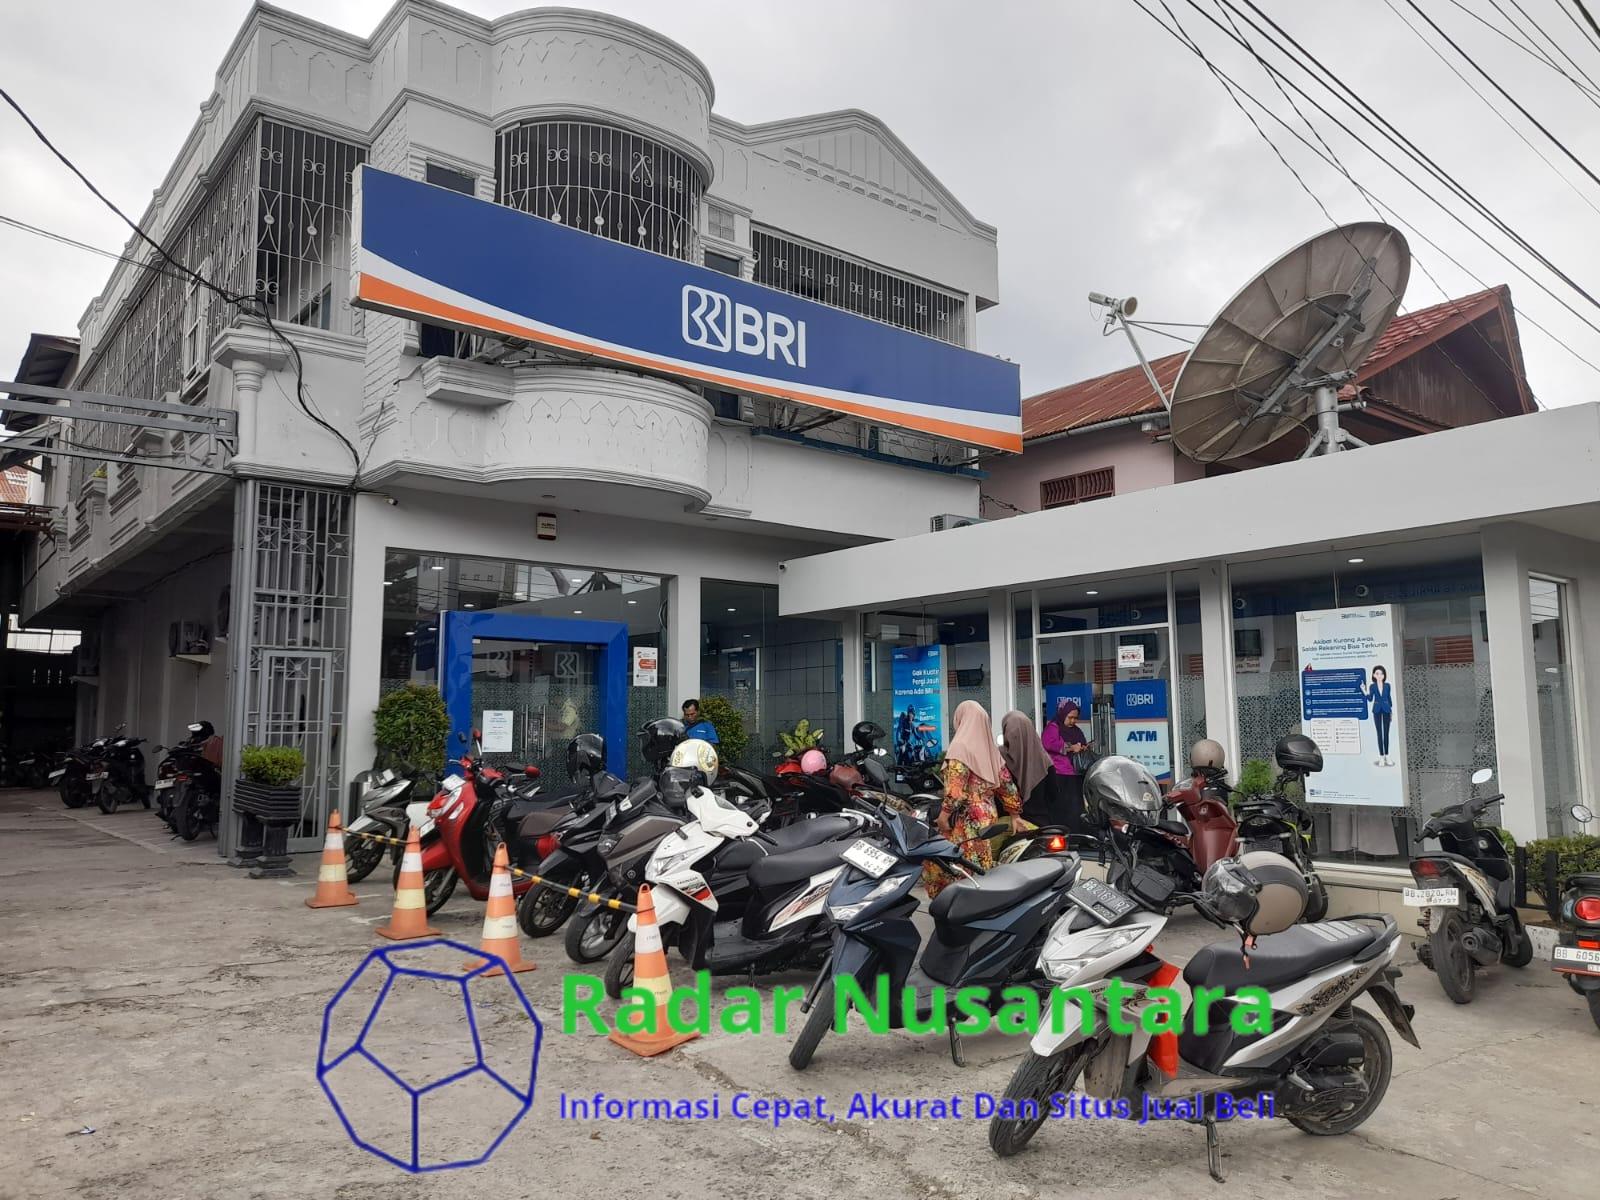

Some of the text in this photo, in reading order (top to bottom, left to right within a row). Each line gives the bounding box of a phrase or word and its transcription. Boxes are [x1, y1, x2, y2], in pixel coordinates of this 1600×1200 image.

[736, 303, 806, 368] BRI
[1137, 694, 1153, 705] BRI
[1127, 731, 1157, 742] ATM
[1556, 949, 1600, 961] BB 6056
